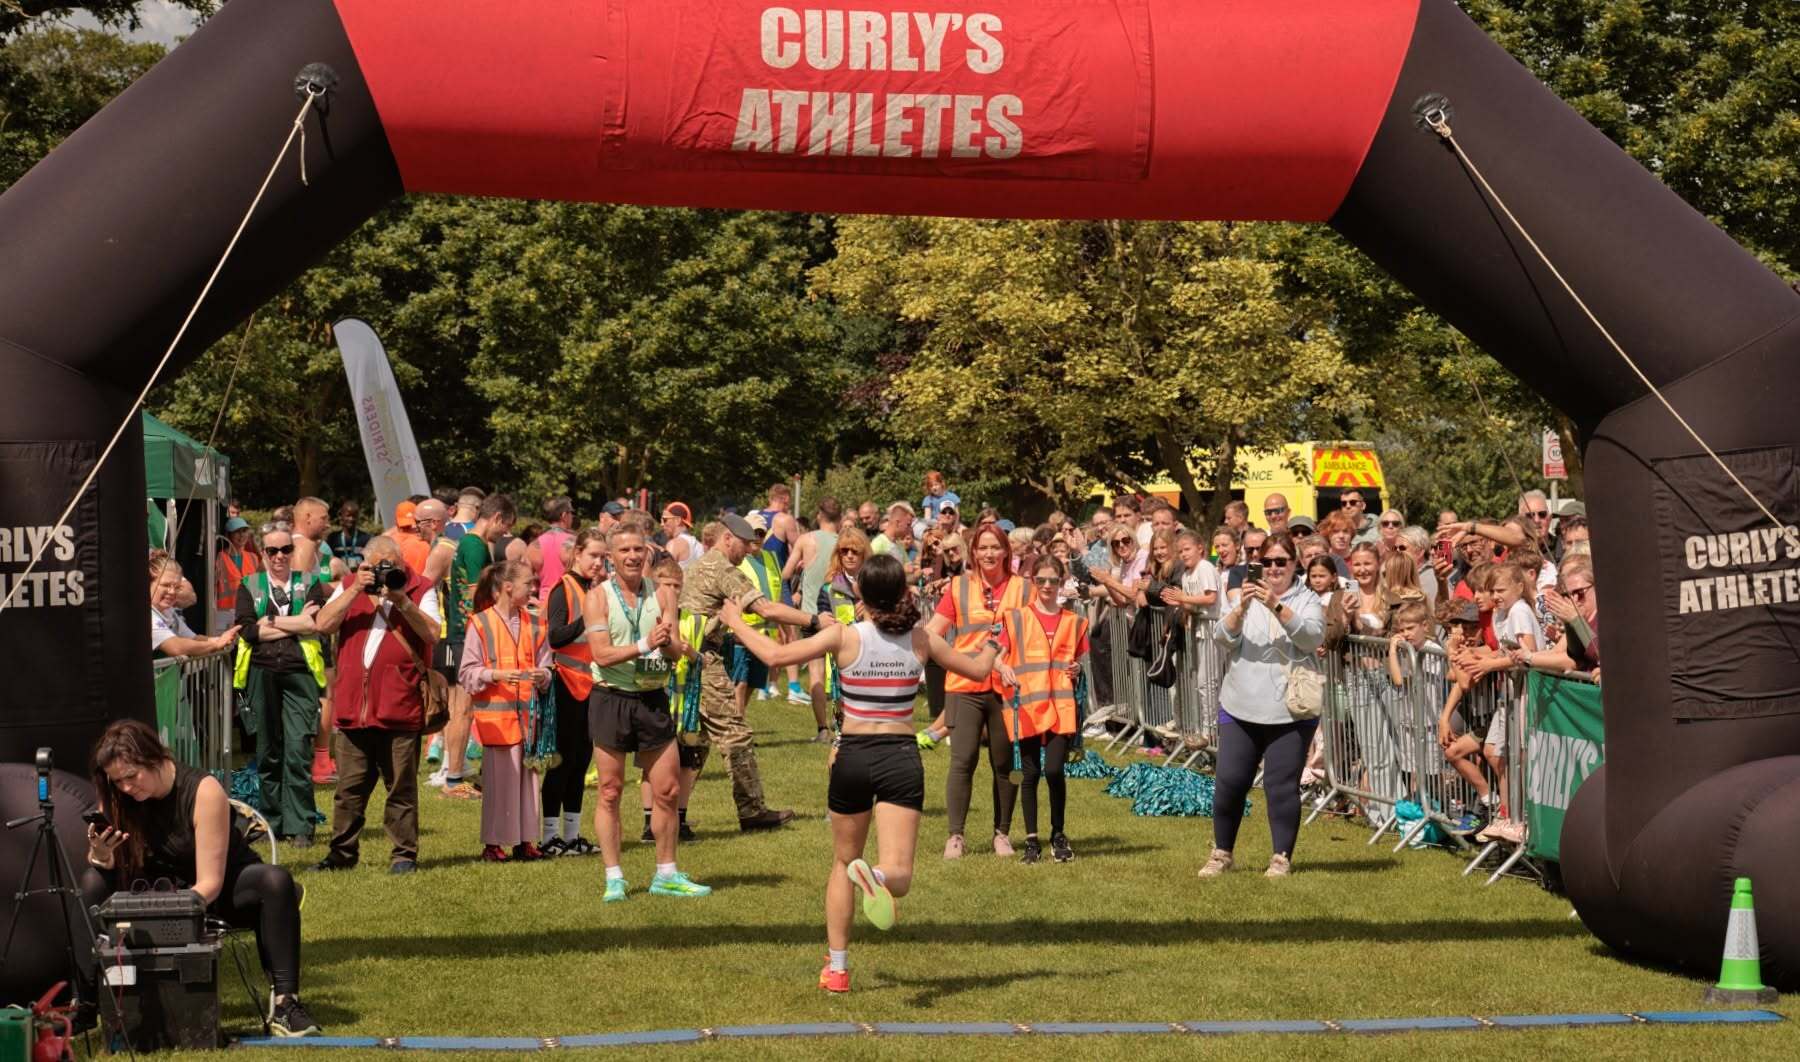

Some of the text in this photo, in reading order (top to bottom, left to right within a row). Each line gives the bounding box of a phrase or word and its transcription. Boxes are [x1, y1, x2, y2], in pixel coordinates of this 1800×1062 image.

[760, 7, 1005, 74] CURLY'S
[731, 88, 1024, 159] ATHLETES
[1324, 461, 1367, 470] AMBULANCE
[0, 525, 75, 562] RLY'S
[1685, 525, 1800, 570] CURLY'S
[0, 570, 85, 608] LETES
[1680, 568, 1800, 614] ATHLETE
[852, 670, 906, 678] Wellington
